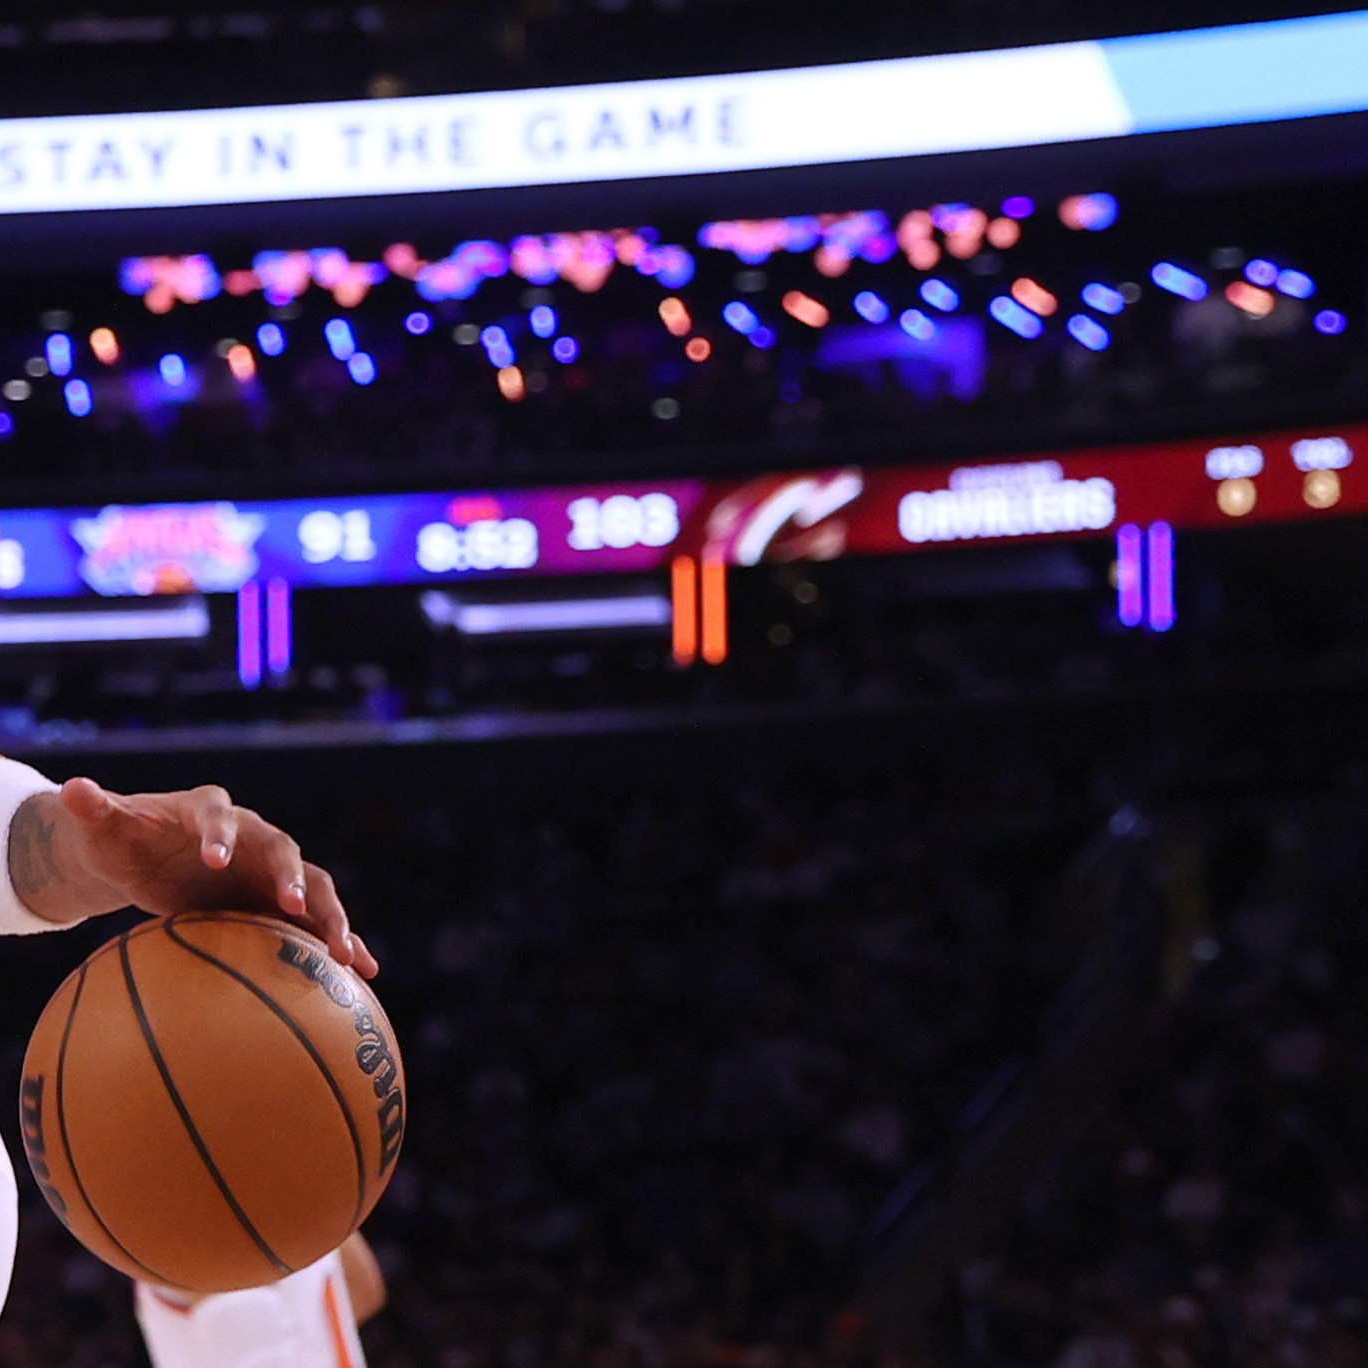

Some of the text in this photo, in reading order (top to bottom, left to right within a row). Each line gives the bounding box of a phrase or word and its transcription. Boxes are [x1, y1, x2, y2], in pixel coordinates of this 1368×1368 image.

[217, 132, 294, 177] IN
[339, 116, 478, 174] THE
[521, 97, 746, 162] GAME
[298, 509, 376, 563] 91
